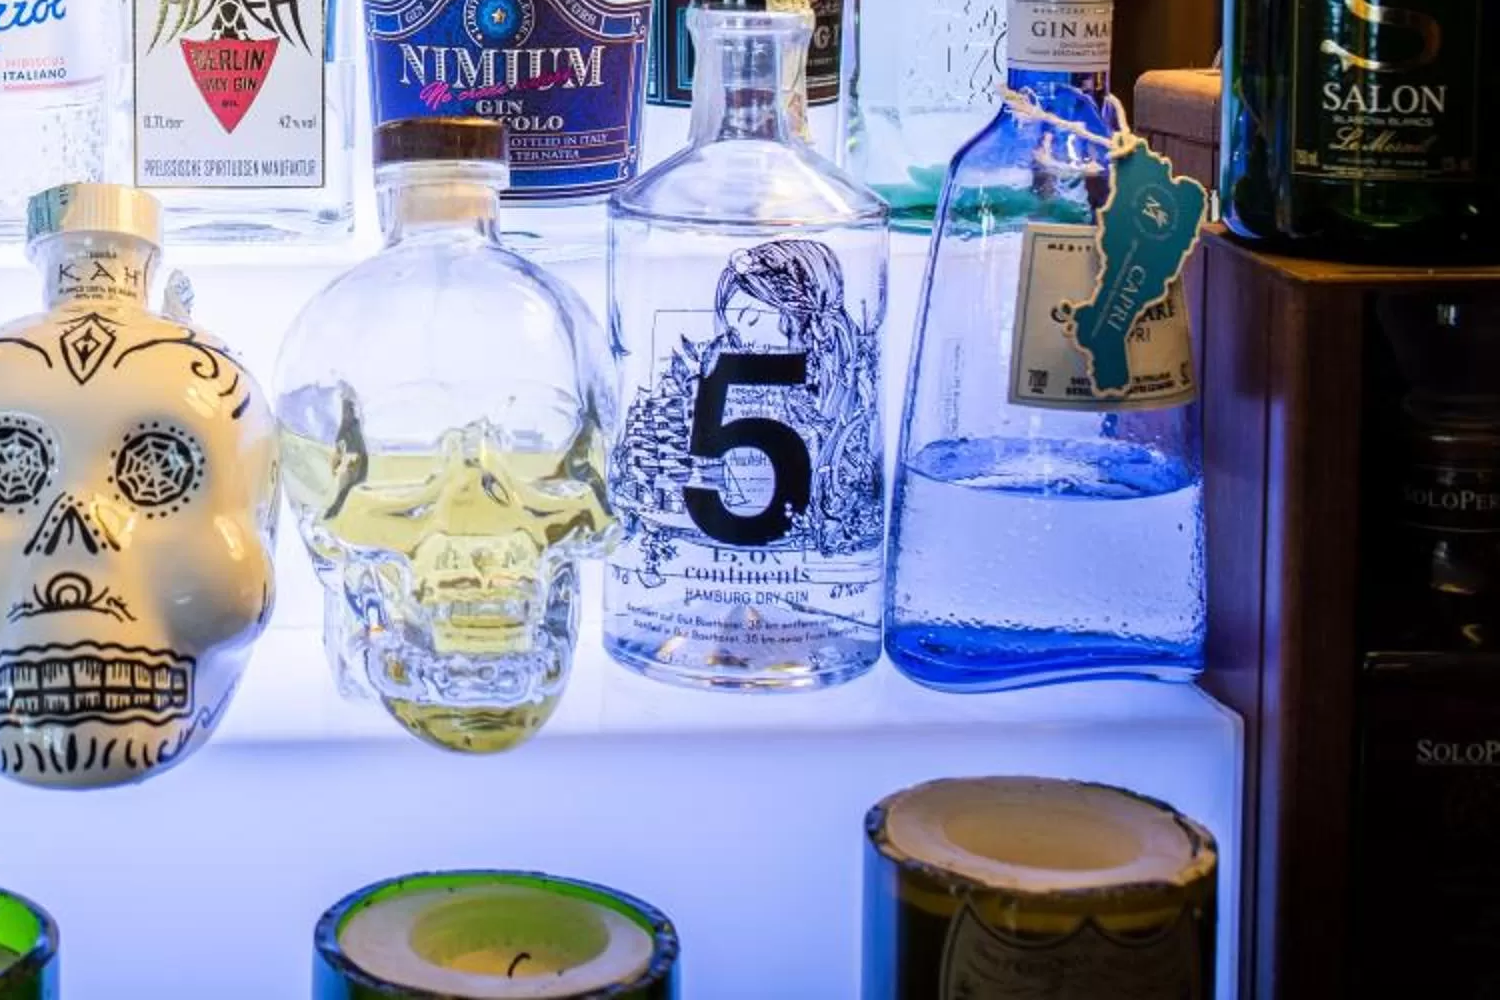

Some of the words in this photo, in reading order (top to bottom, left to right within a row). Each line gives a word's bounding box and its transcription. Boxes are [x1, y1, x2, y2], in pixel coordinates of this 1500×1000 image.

[404, 2, 427, 24] GIN
[1031, 20, 1077, 38] GIN
[192, 48, 265, 72] BERLIN
[399, 43, 606, 91] NIMIUM
[2, 67, 68, 80] ITALIANO
[233, 77, 258, 91] GIN
[474, 99, 524, 115] GIN
[1321, 81, 1449, 114] SALON
[510, 137, 561, 147] OTTLED
[563, 136, 577, 146] IN
[579, 133, 608, 145] ITALY
[58, 261, 141, 287] KAH
[1107, 265, 1146, 332] CAPRI
[683, 352, 813, 546] 5
[684, 564, 812, 585] continents
[685, 589, 749, 605] HAMBURG
[755, 590, 784, 605] DRY
[786, 590, 808, 604] GIN
